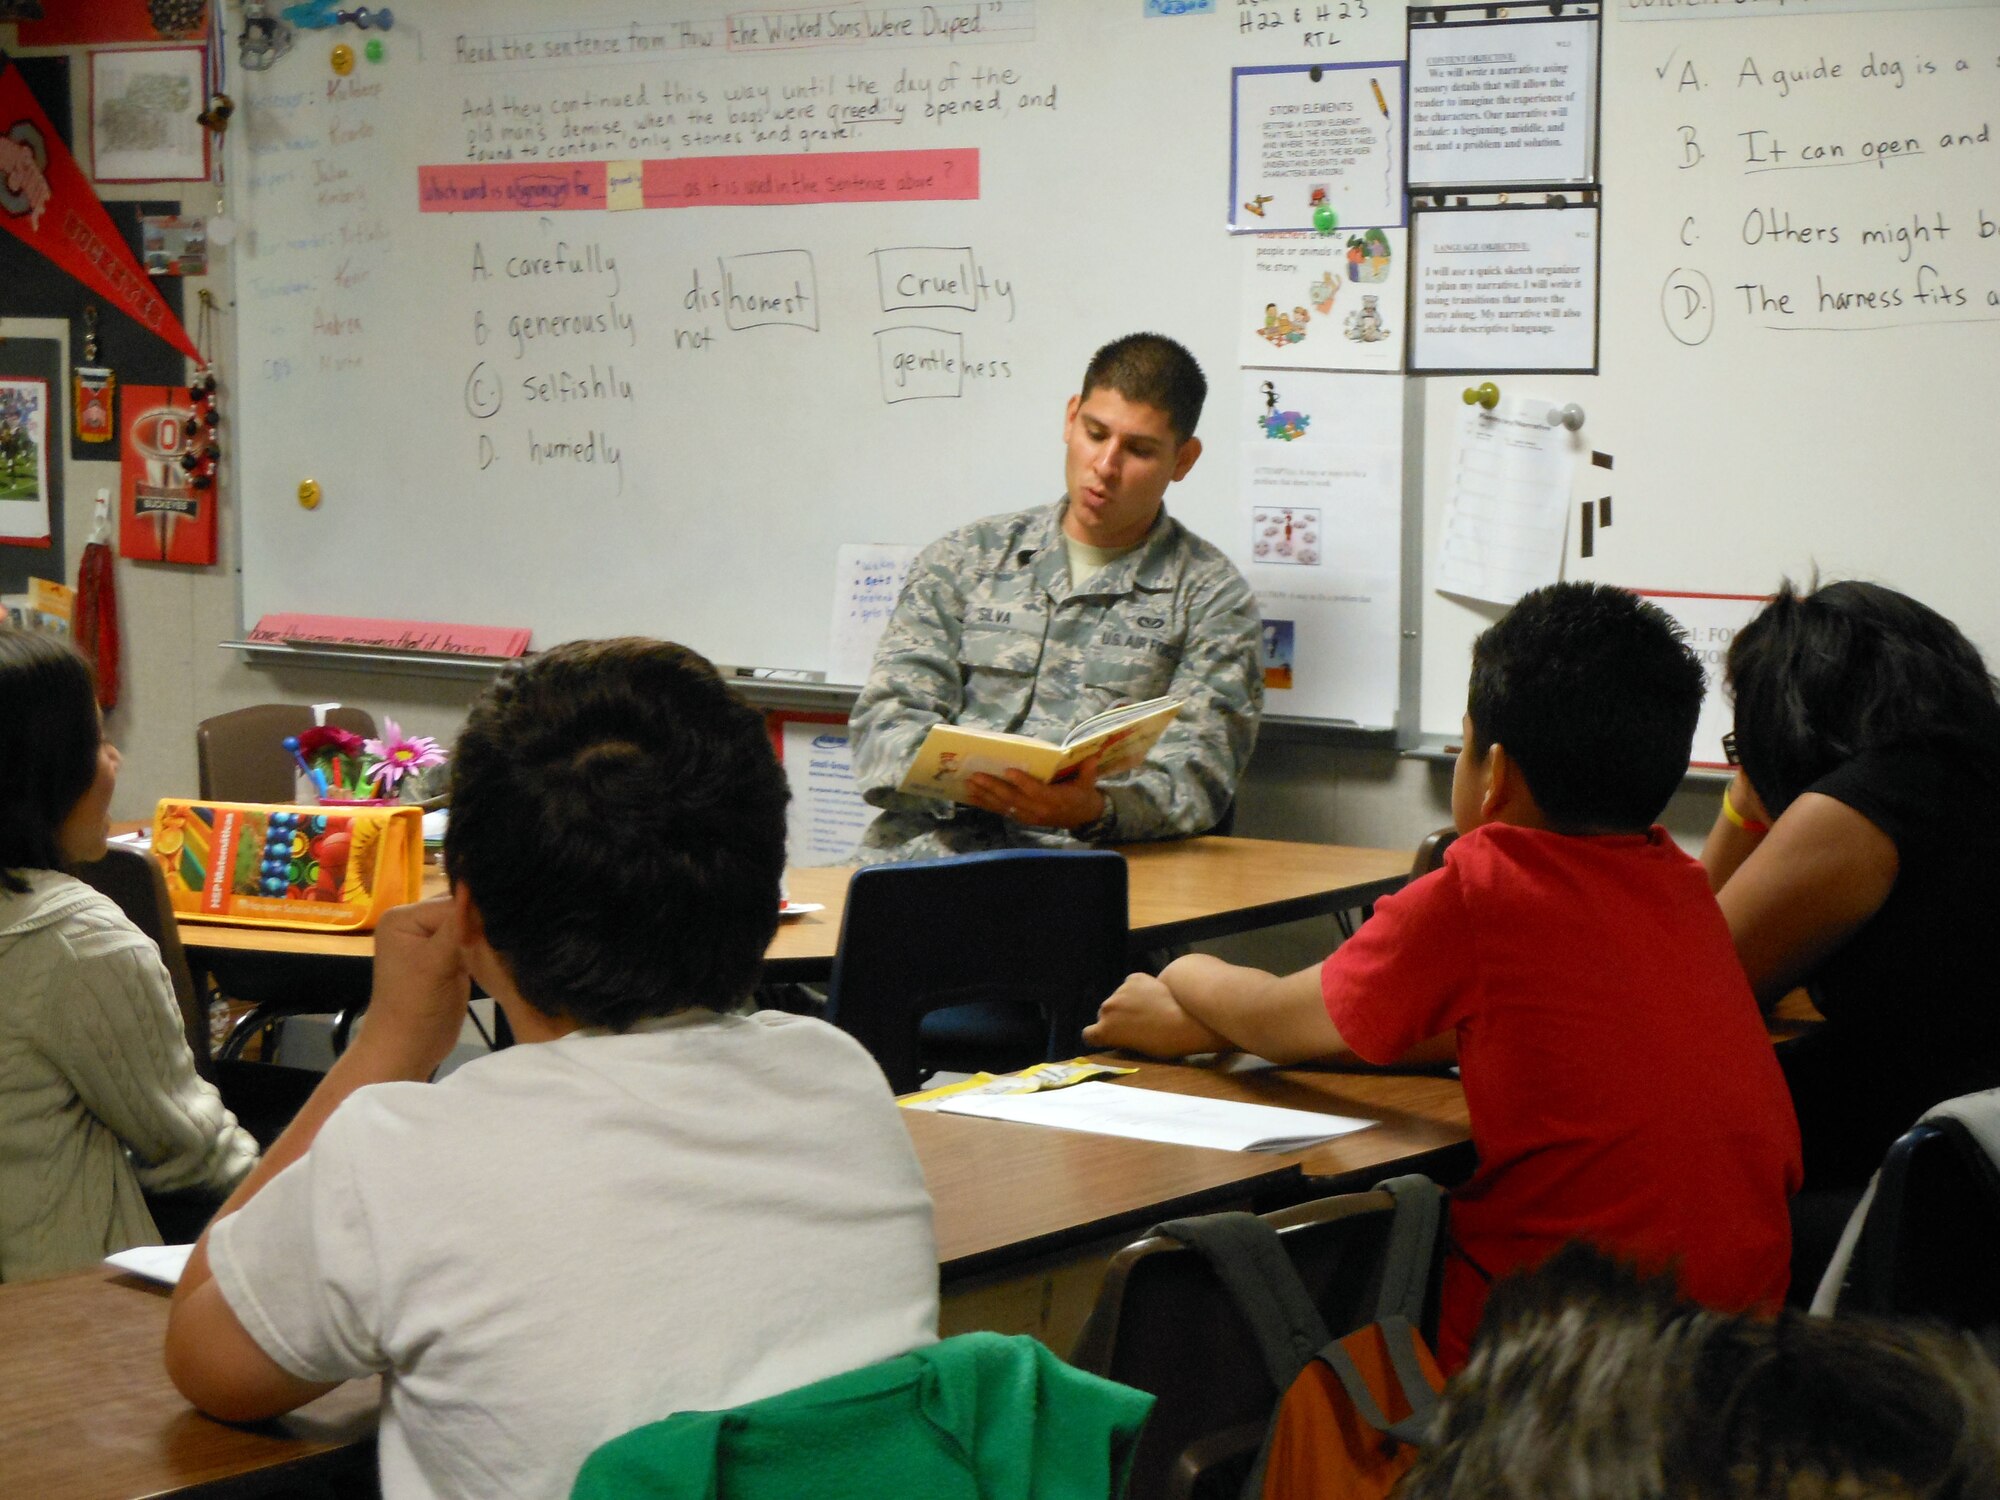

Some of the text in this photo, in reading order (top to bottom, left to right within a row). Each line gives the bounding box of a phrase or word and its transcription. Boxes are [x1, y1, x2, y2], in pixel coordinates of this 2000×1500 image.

[456, 33, 496, 63] Read
[500, 37, 535, 60] the
[544, 30, 620, 58] sentence
[627, 20, 666, 51] from
[729, 18, 759, 45] the
[761, 10, 822, 44] Wicked
[827, 9, 861, 38] Sons
[864, 8, 913, 39] Were
[1238, 10, 1285, 35] H22
[1316, 0, 1369, 22] H23
[1302, 31, 1342, 48] RTL
[461, 60, 1023, 119] And they continued this way until the day of the
[1503, 79, 1521, 90] will
[1678, 51, 1970, 99] A. A guide dog is a
[466, 120, 494, 145] old
[633, 111, 676, 132] when
[686, 111, 714, 126] the
[727, 105, 766, 133] bags
[773, 104, 816, 121] were
[827, 94, 906, 131] greedily
[1017, 84, 1058, 112] and
[1302, 101, 1354, 115] ELEMENTS
[466, 142, 513, 162] found
[519, 146, 539, 158] to
[546, 138, 618, 160] contain
[628, 132, 671, 154] only
[680, 130, 743, 148] stones
[754, 124, 791, 143] and
[1676, 122, 1991, 171] B. It can open and
[1679, 206, 2000, 264] C. Others might b
[471, 241, 622, 299] A. carefully
[1432, 266, 1450, 277] will
[1504, 264, 1534, 275] sketch
[1672, 264, 1968, 321] D. The harness fits
[507, 302, 639, 361] generously
[673, 326, 718, 354] not
[892, 351, 1013, 388] gentleness
[977, 606, 1013, 626] SILVA
[1125, 634, 1149, 649] AIR
